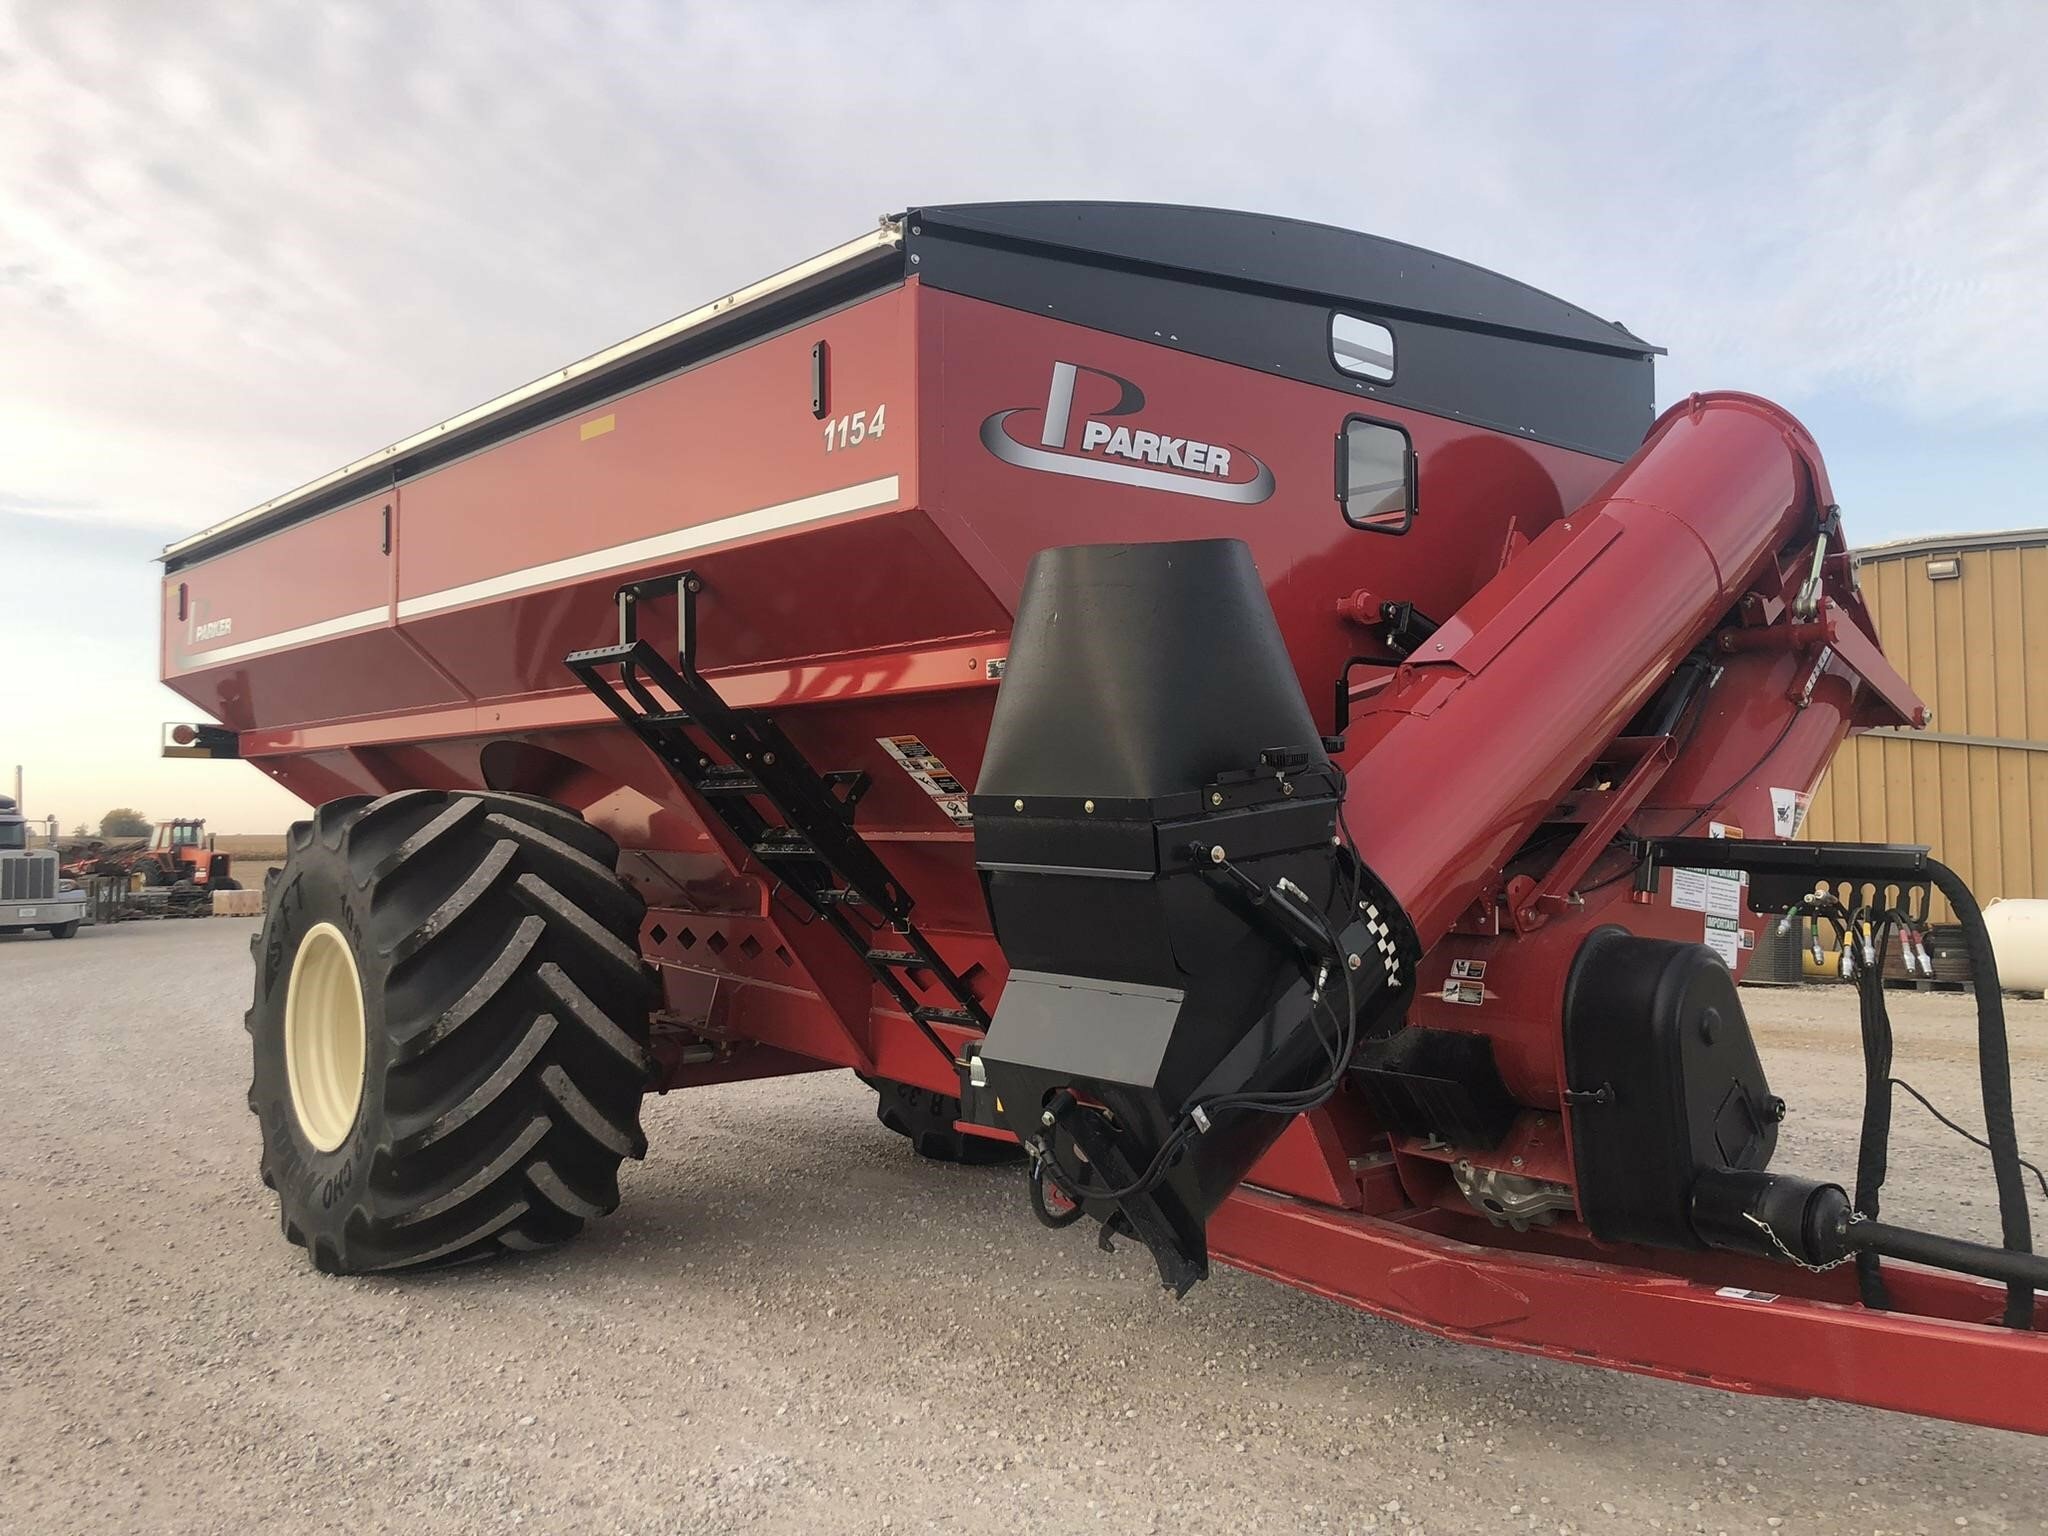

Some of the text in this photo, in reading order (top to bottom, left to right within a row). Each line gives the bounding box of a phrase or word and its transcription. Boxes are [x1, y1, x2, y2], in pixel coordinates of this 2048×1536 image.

[824, 403, 886, 452] 1154
[1081, 419, 1232, 478] PARKER
[195, 618, 231, 641] PARKER
[1706, 915, 1738, 932] IMPORTANT
